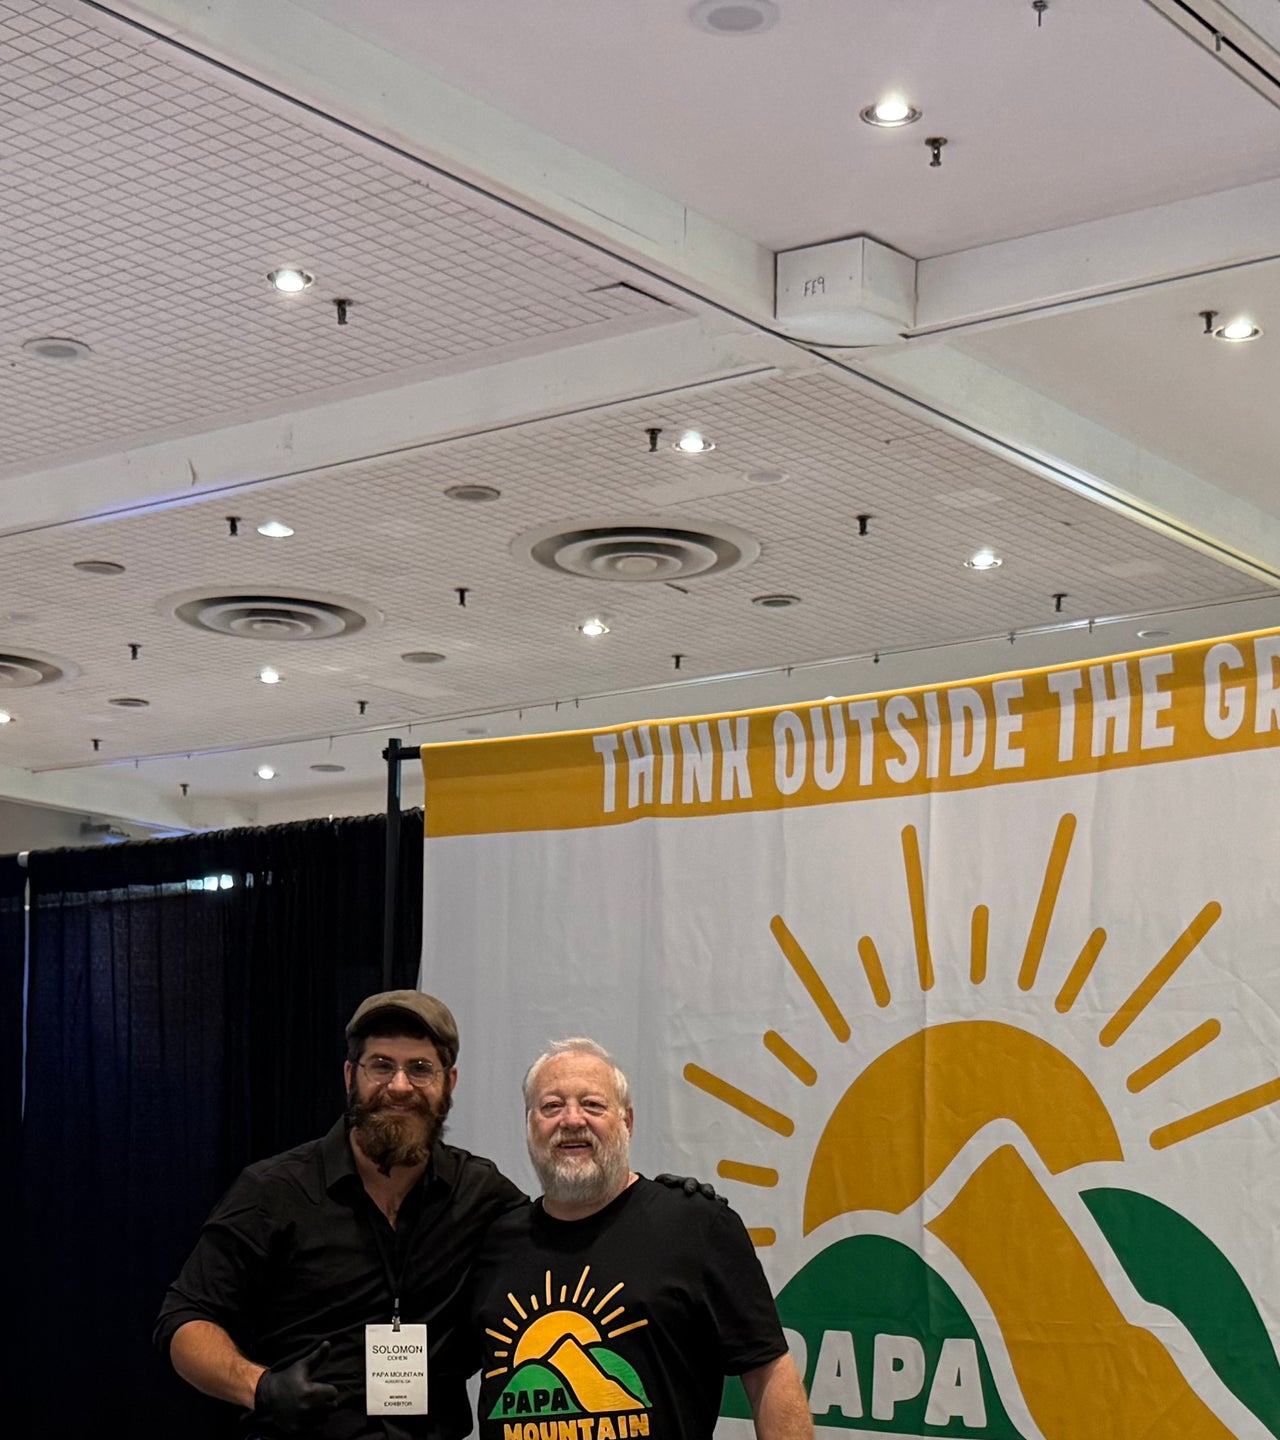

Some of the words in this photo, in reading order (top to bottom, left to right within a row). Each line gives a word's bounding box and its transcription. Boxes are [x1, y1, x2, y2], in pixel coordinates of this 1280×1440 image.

[593, 717, 752, 813] THINK
[773, 678, 1025, 796] OUTSIDE
[1047, 653, 1174, 763] THE
[372, 1345, 422, 1354] SOLOMON
[502, 1388, 569, 1414] PAPA
